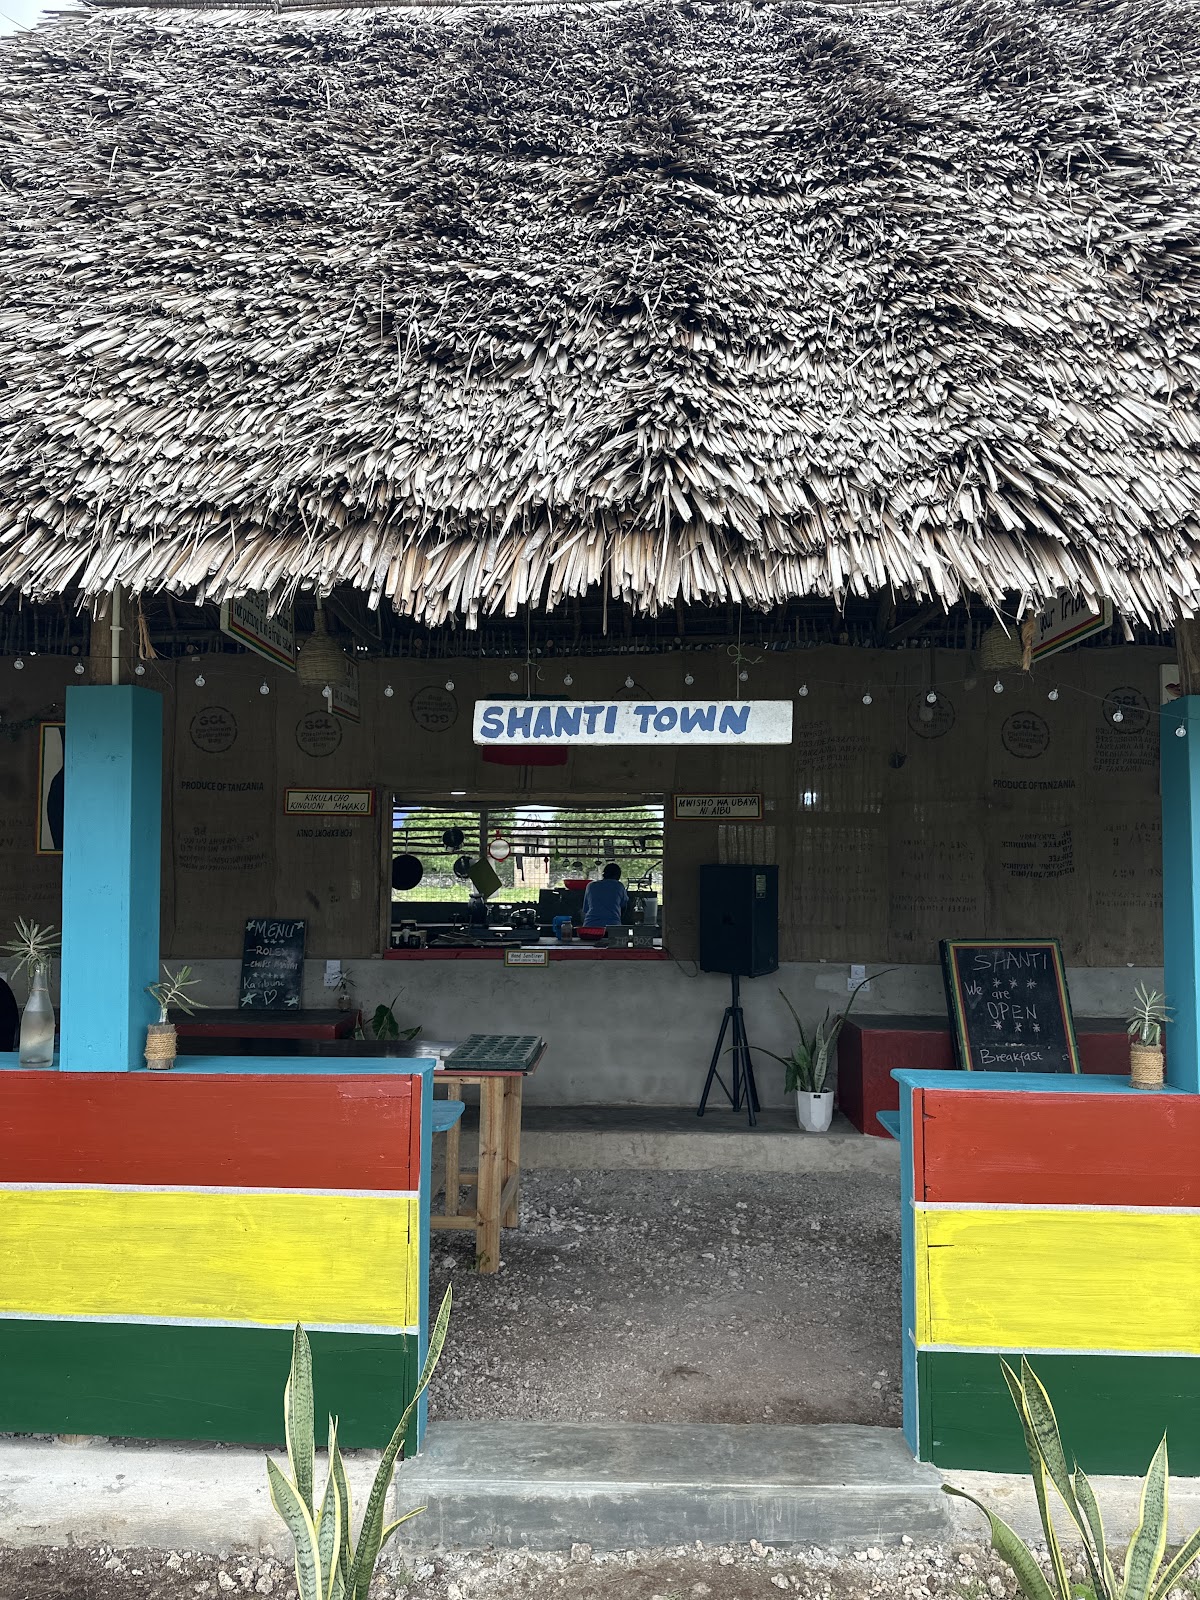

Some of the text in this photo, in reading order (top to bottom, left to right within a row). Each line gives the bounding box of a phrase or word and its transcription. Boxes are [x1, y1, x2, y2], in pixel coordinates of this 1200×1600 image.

[199, 714, 226, 726] GCL
[421, 713, 449, 724] GCL
[480, 705, 751, 739] SHANTI TOWN
[304, 719, 332, 730] GCL
[1012, 719, 1040, 731] GCL
[181, 780, 264, 792] PRODUCE OF TANZANIA
[993, 779, 1076, 790] PRODUCE OF TANZANIA
[304, 793, 350, 802] KIKULACHO
[678, 797, 758, 808] MWISHO WA UBAYA
[333, 801, 366, 811] MWAKO
[700, 806, 731, 816] NI AIBU
[296, 828, 353, 838] FOR EXPORT ONLY
[254, 920, 295, 939] MENU
[633, 936, 652, 946] BOX
[973, 951, 1047, 973] SHANTI
[964, 980, 1011, 1000] We are
[987, 1001, 1038, 1021] OPEN
[980, 1049, 1044, 1067] Breakfast
